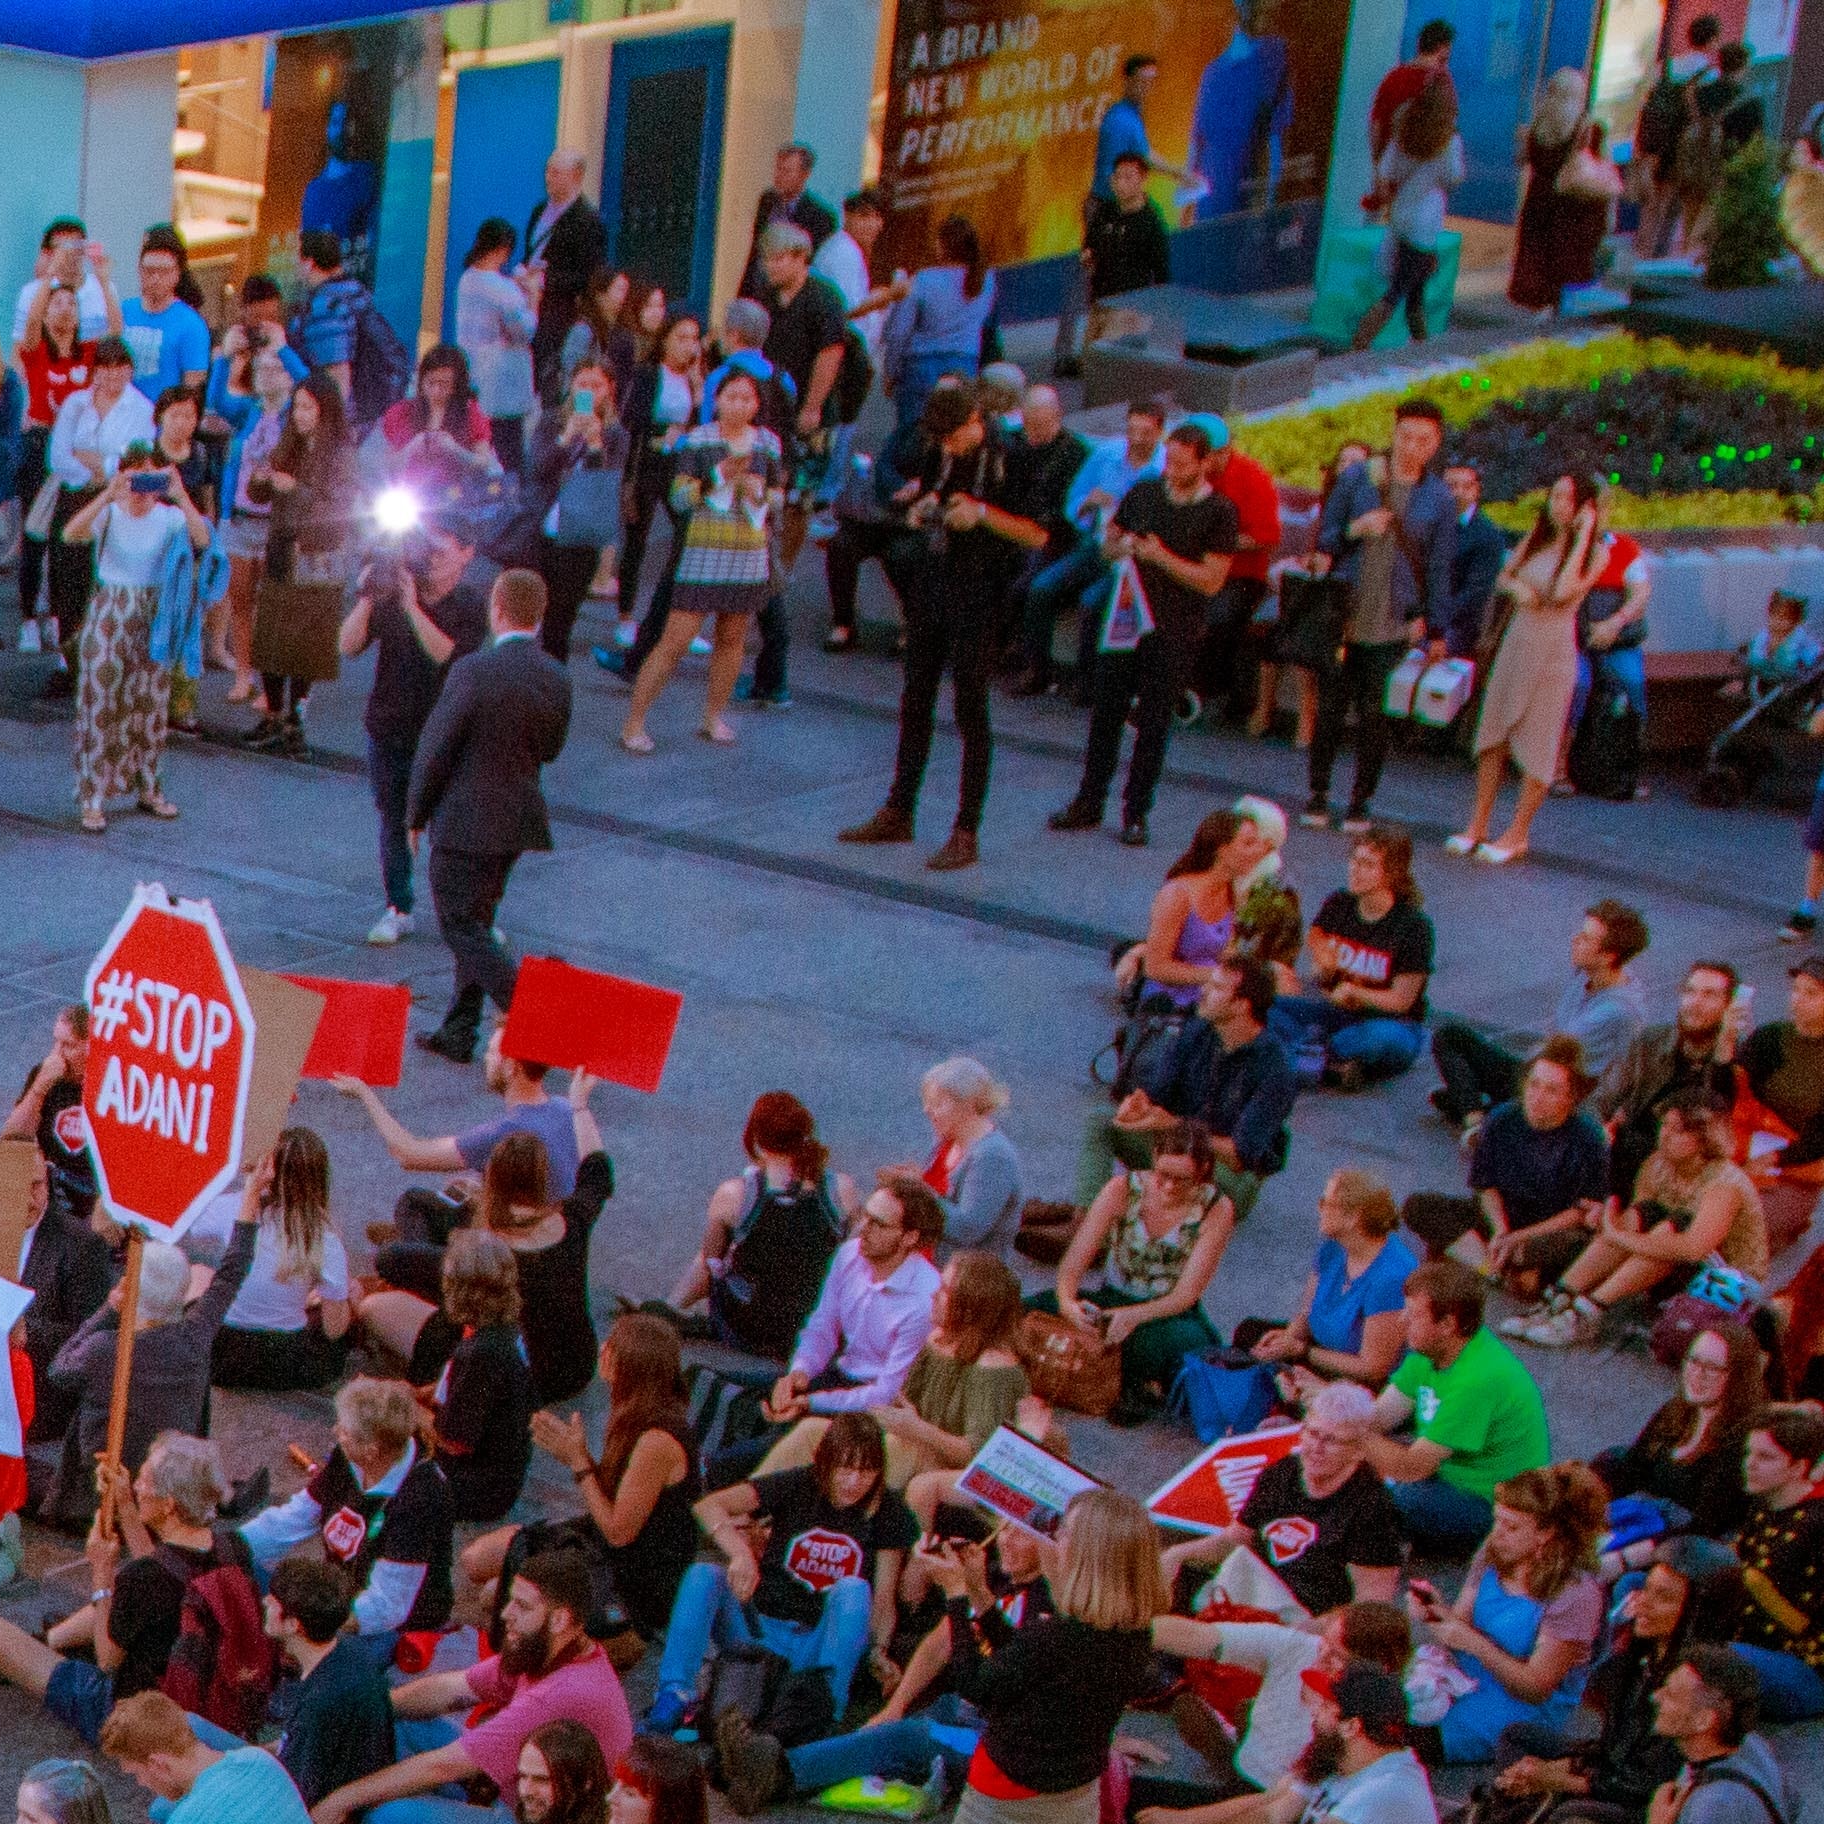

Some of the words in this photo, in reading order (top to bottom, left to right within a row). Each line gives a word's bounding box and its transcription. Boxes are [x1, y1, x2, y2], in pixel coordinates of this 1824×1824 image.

[909, 31, 929, 69] A
[939, 14, 1040, 67] BRAND
[904, 71, 969, 118] NEW
[978, 52, 1077, 101] WORLD
[1087, 44, 1123, 85] OF
[898, 92, 1113, 167] PERFORMANCE
[93, 969, 234, 1071] #STOP
[95, 1054, 214, 1154] ADANI
